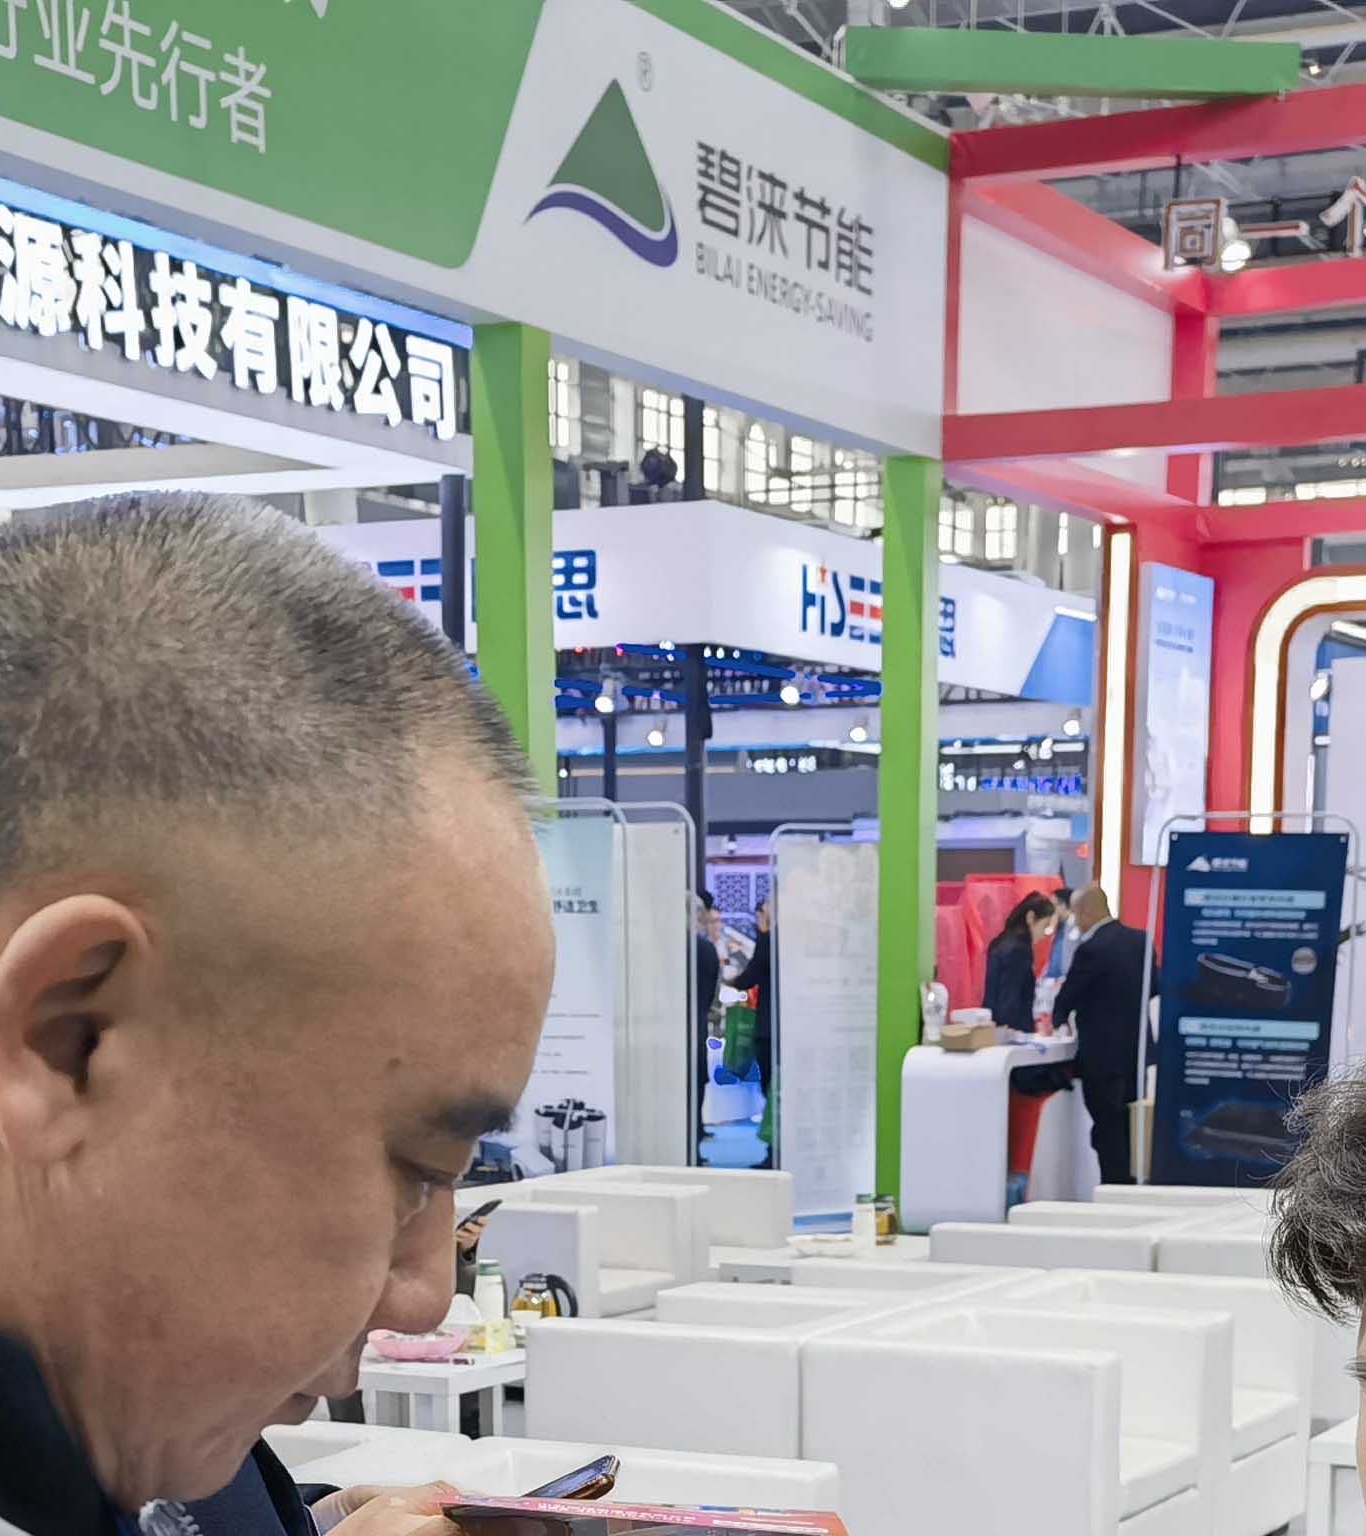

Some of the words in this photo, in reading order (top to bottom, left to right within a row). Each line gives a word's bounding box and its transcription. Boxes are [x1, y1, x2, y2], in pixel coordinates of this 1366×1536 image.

[696, 140, 873, 296] 碧涞节能
[747, 262, 873, 343] ENERGY-SAVING
